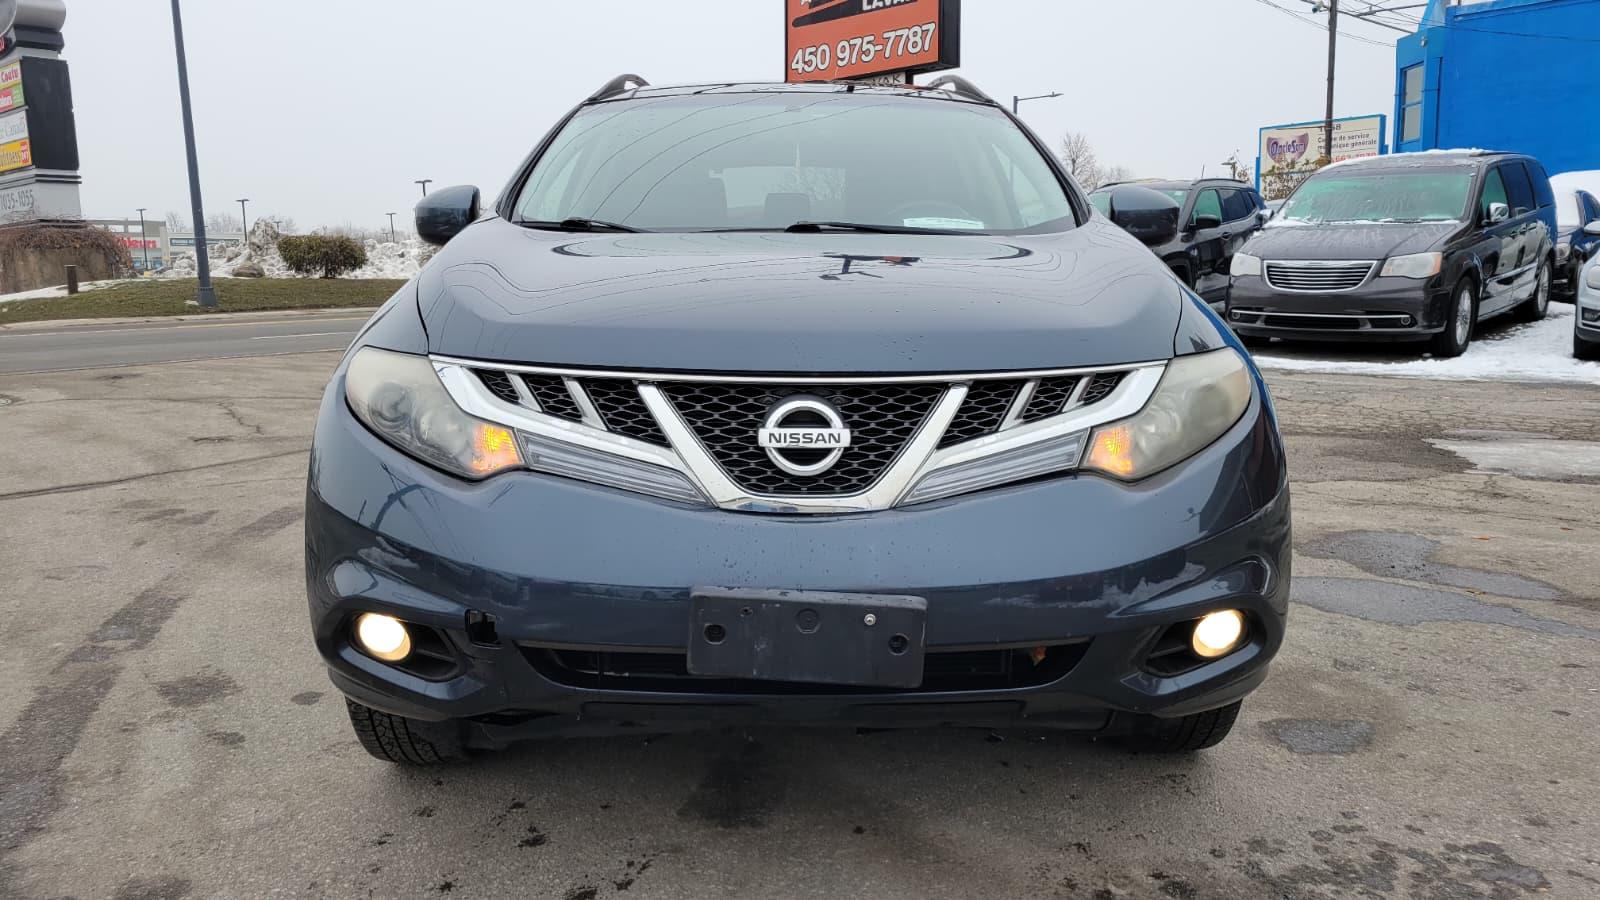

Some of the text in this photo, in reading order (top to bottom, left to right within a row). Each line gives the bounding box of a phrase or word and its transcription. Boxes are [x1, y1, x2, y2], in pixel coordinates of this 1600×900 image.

[791, 22, 936, 74] 450 975-7787
[769, 432, 841, 444] NISSAN
